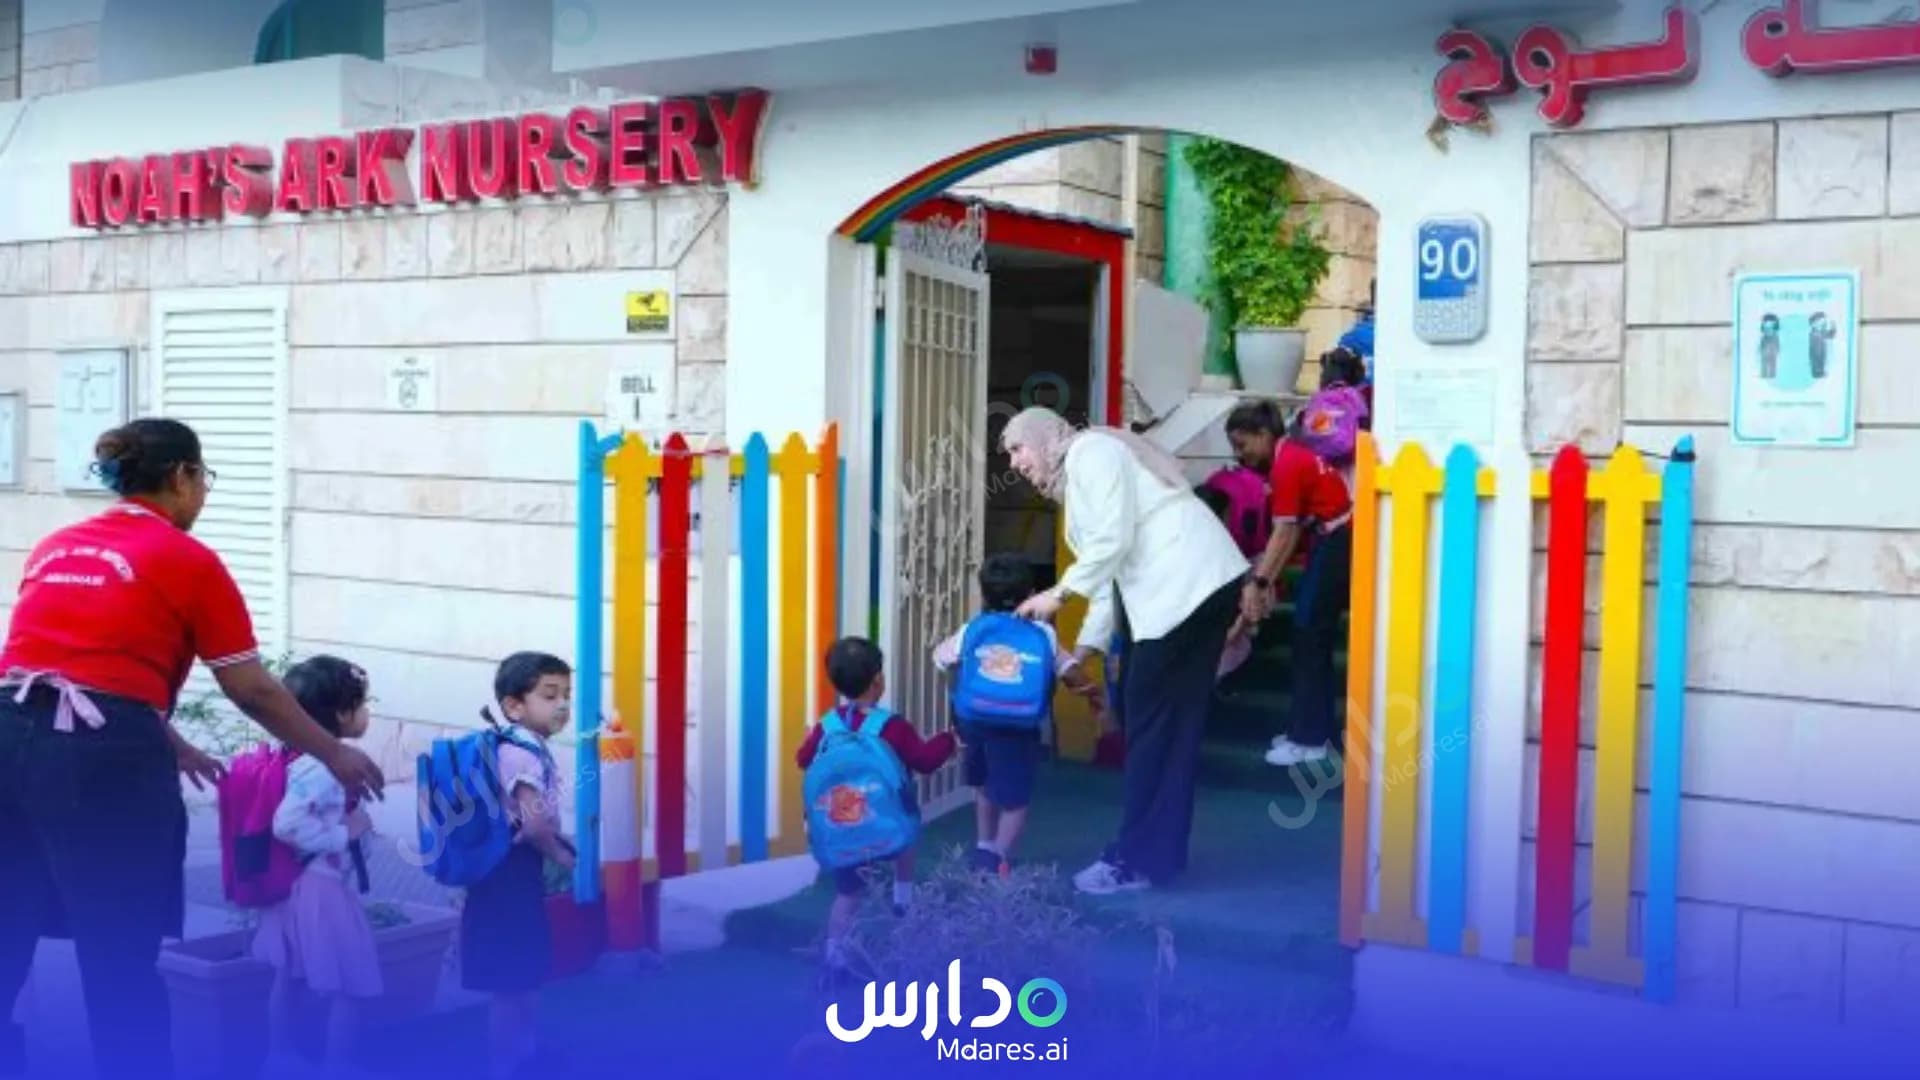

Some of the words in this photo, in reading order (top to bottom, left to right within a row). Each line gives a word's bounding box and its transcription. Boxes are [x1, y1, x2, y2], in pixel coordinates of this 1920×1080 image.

[70, 143, 272, 230] NOAH'S
[276, 128, 413, 213] ARK
[420, 87, 774, 203] NURSERY
[1421, 237, 1477, 281] 90
[621, 376, 656, 394] BELL
